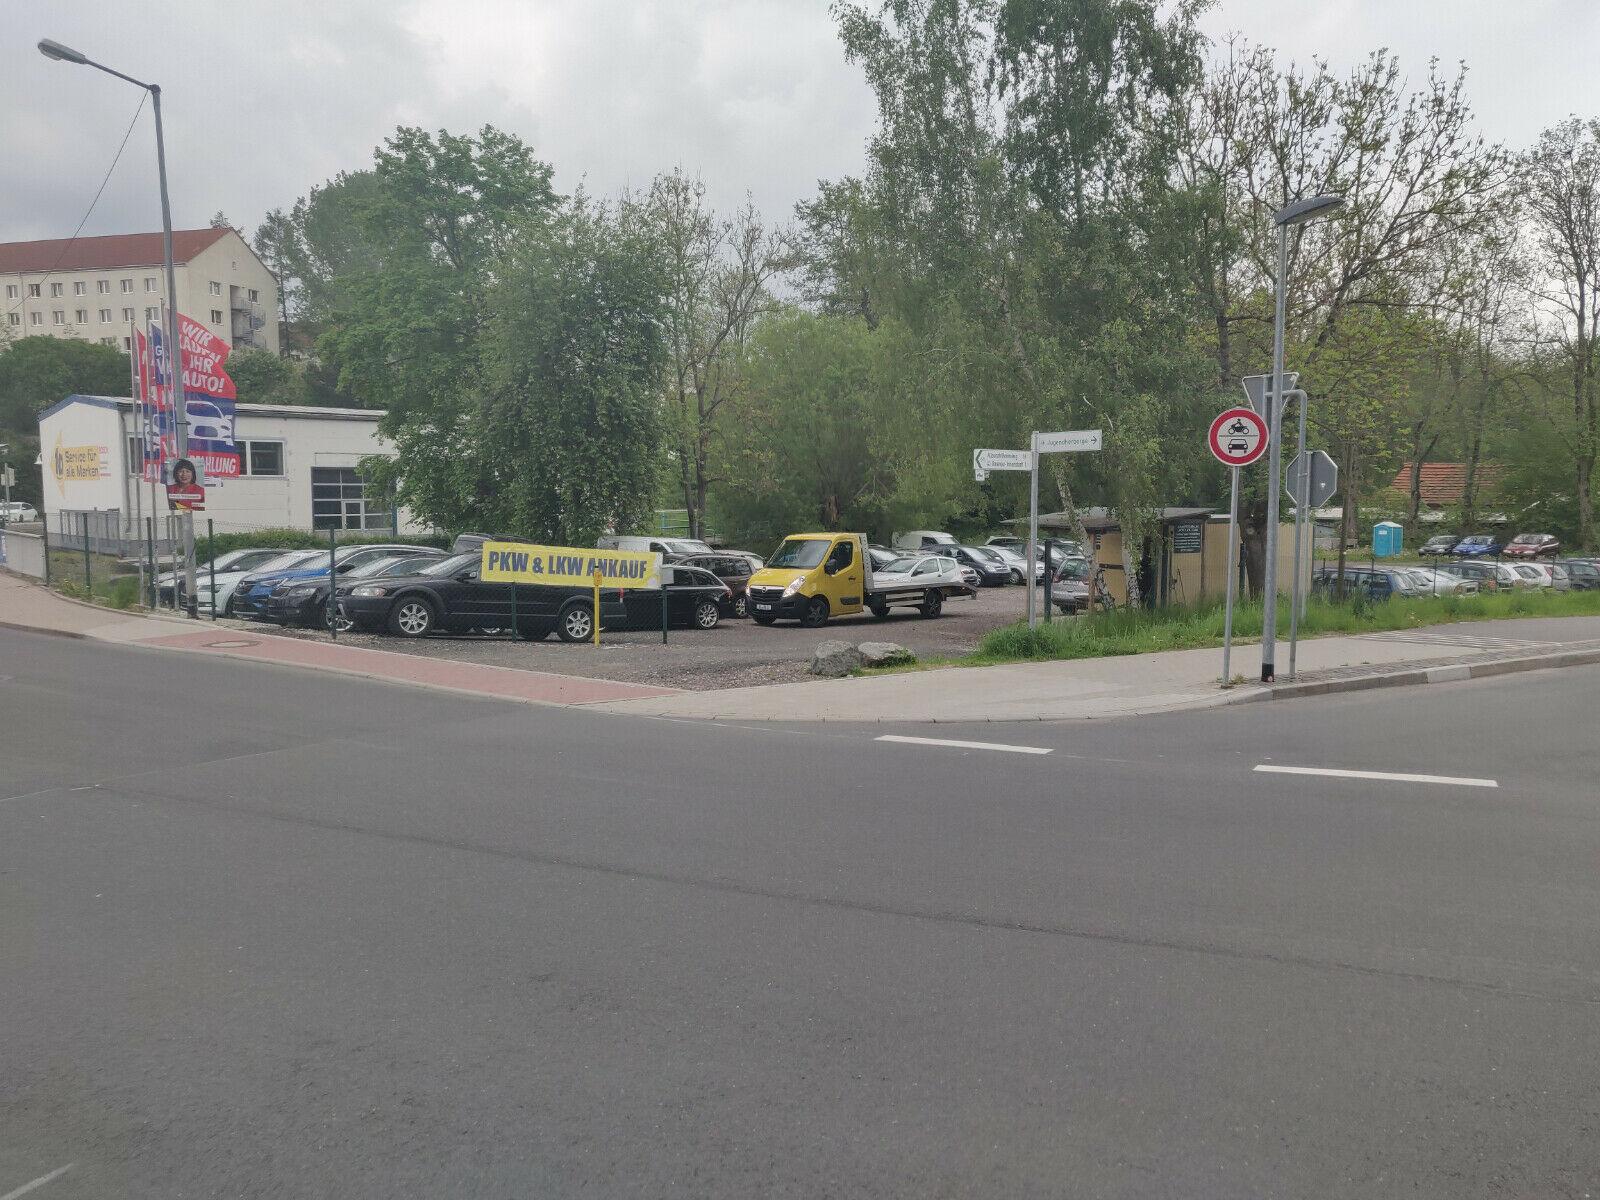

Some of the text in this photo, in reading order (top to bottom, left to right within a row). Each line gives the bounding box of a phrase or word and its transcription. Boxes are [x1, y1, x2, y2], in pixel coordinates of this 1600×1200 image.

[182, 321, 214, 346] WIR
[190, 354, 214, 374] IHR
[182, 370, 225, 393] AUTO!
[65, 450, 86, 463] Service
[488, 551, 648, 580] PKW & LKW ANKAUF
